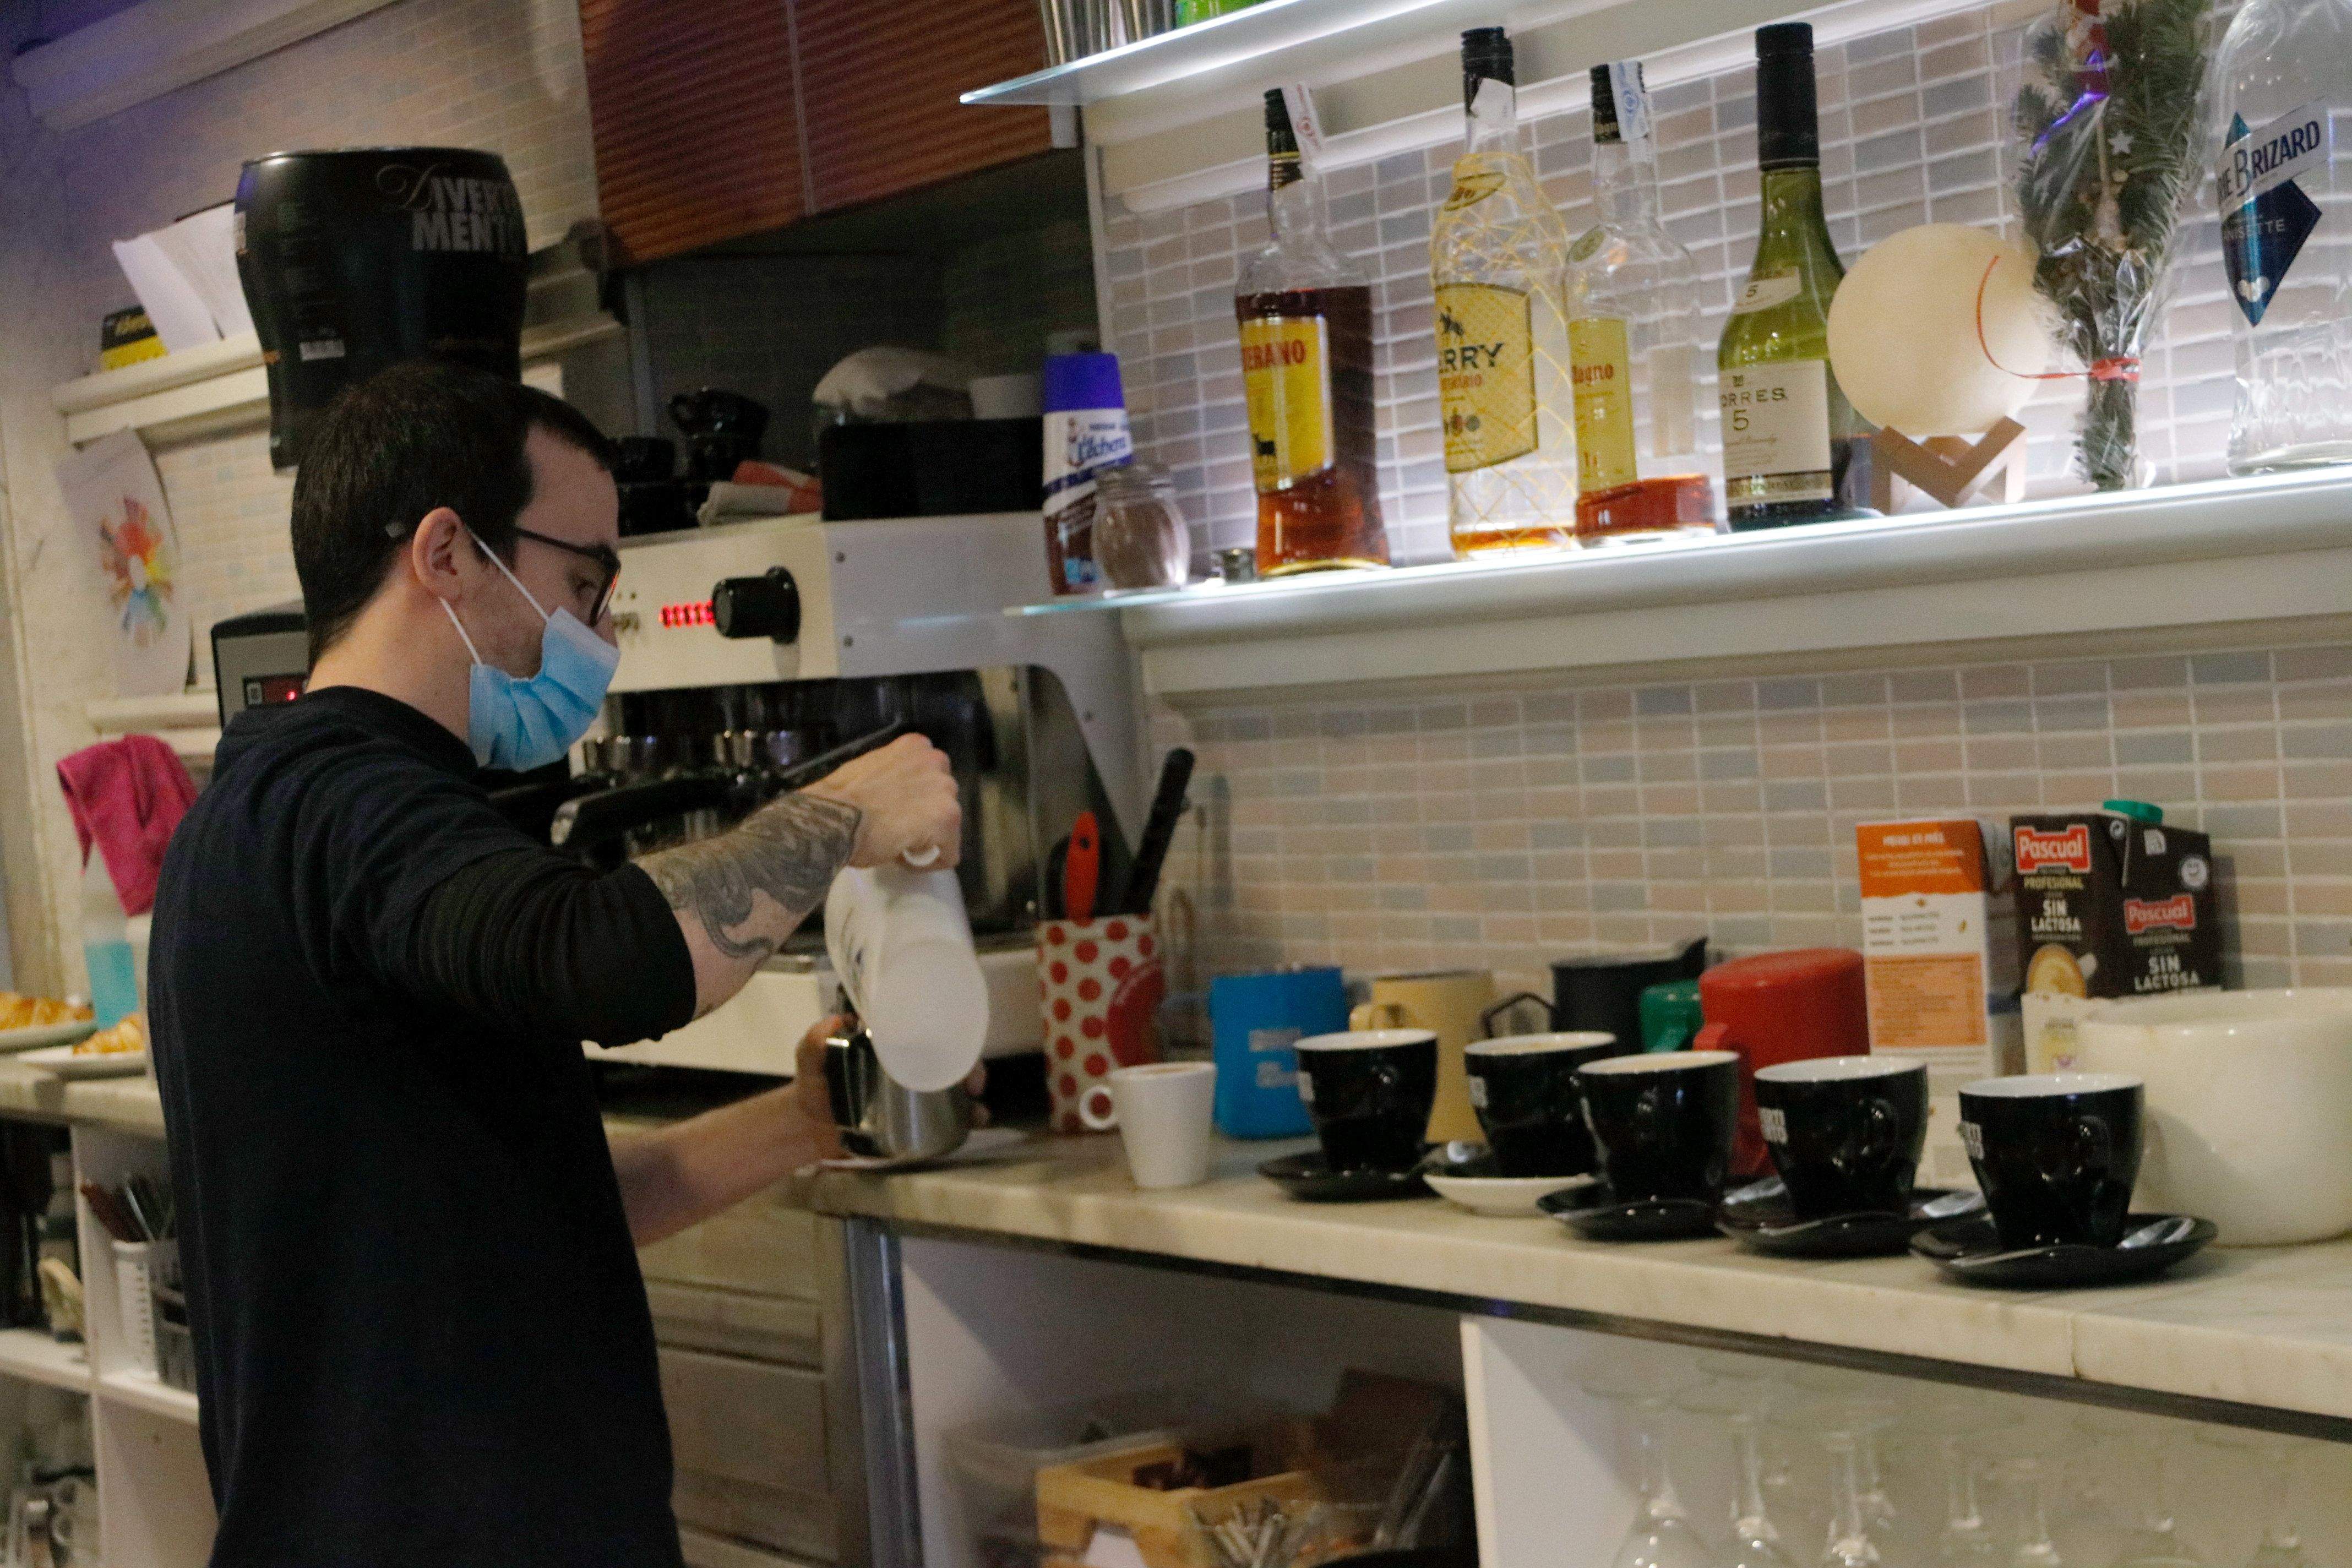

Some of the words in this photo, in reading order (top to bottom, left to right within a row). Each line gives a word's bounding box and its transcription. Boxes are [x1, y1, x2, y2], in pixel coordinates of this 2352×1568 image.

[2234, 120, 2320, 197] BRIZARD
[1733, 409, 1749, 431] 5
[2019, 834, 2083, 859] Pascual
[2043, 899, 2067, 917] SIN
[2128, 901, 2187, 922] Pascual
[2030, 916, 2081, 932] LACTOSA
[2148, 954, 2180, 974] SIN
[2134, 970, 2200, 991] LACTOSA
